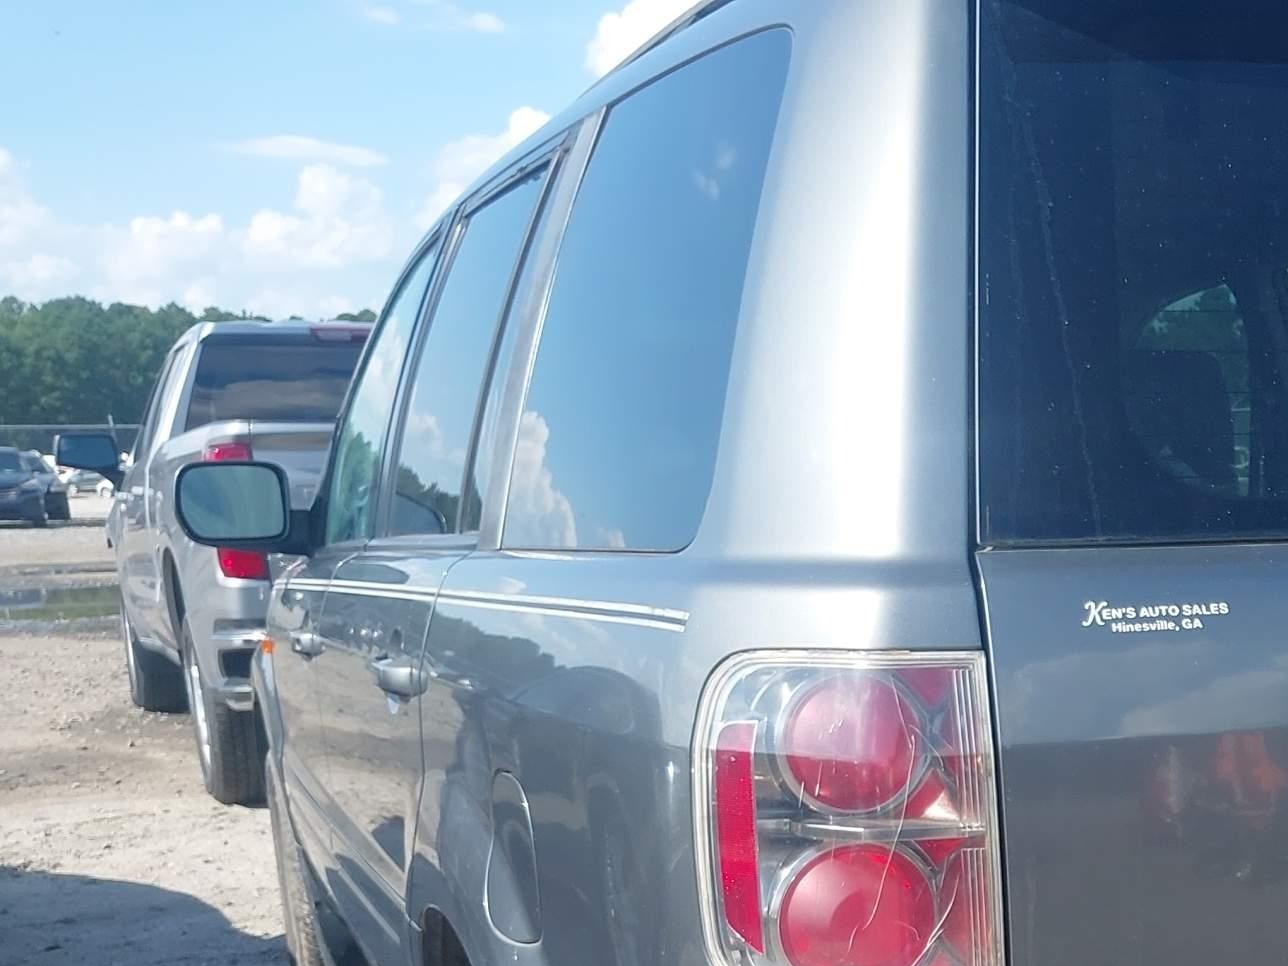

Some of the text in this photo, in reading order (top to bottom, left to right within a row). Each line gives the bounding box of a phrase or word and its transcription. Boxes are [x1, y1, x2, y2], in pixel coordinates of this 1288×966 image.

[1139, 605, 1180, 618] AUTO
[1182, 602, 1229, 616] SALES
[1111, 618, 1203, 633] Hinesville, GA
